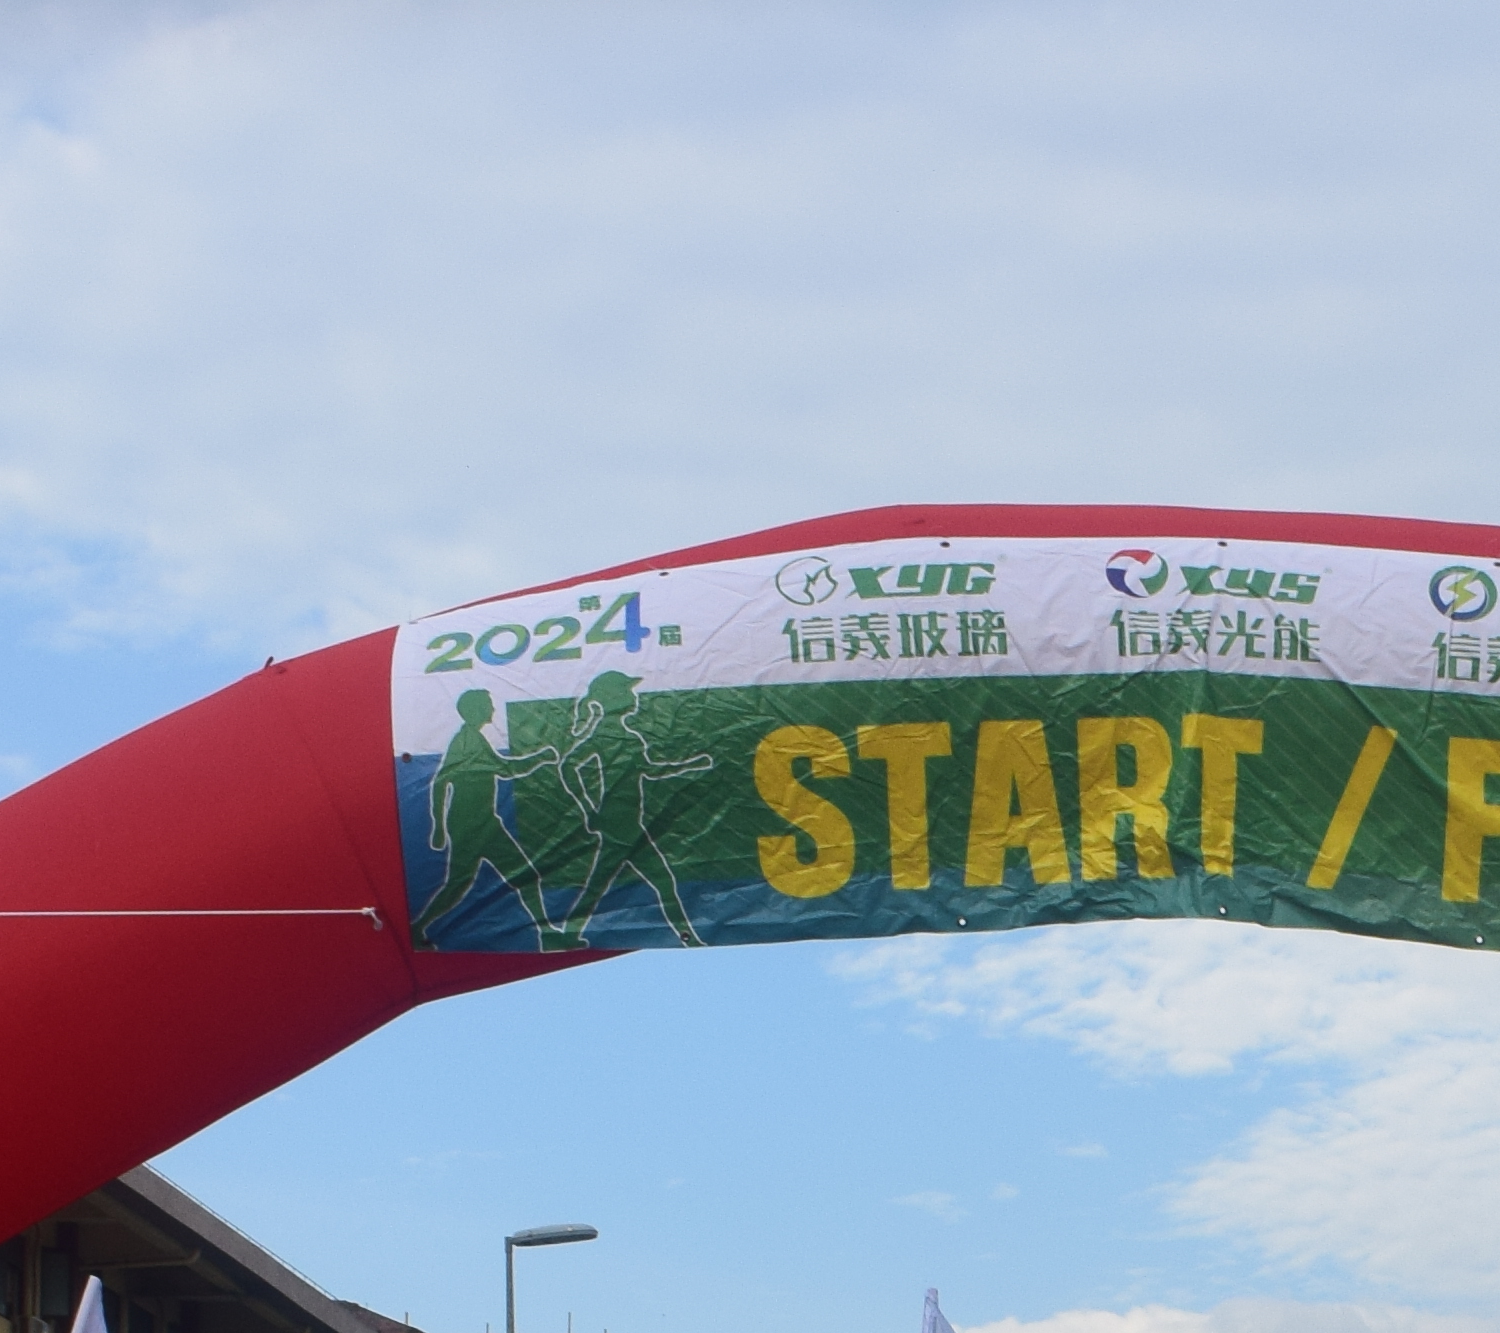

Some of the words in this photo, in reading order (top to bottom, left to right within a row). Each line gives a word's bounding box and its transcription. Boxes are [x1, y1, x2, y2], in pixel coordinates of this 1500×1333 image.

[849, 562, 996, 599] XYG
[1177, 564, 1321, 605] XYS
[424, 591, 652, 674] 2024
[781, 608, 1009, 663] 信義玻璃
[754, 713, 1265, 899] START
[1306, 724, 1400, 890] /
